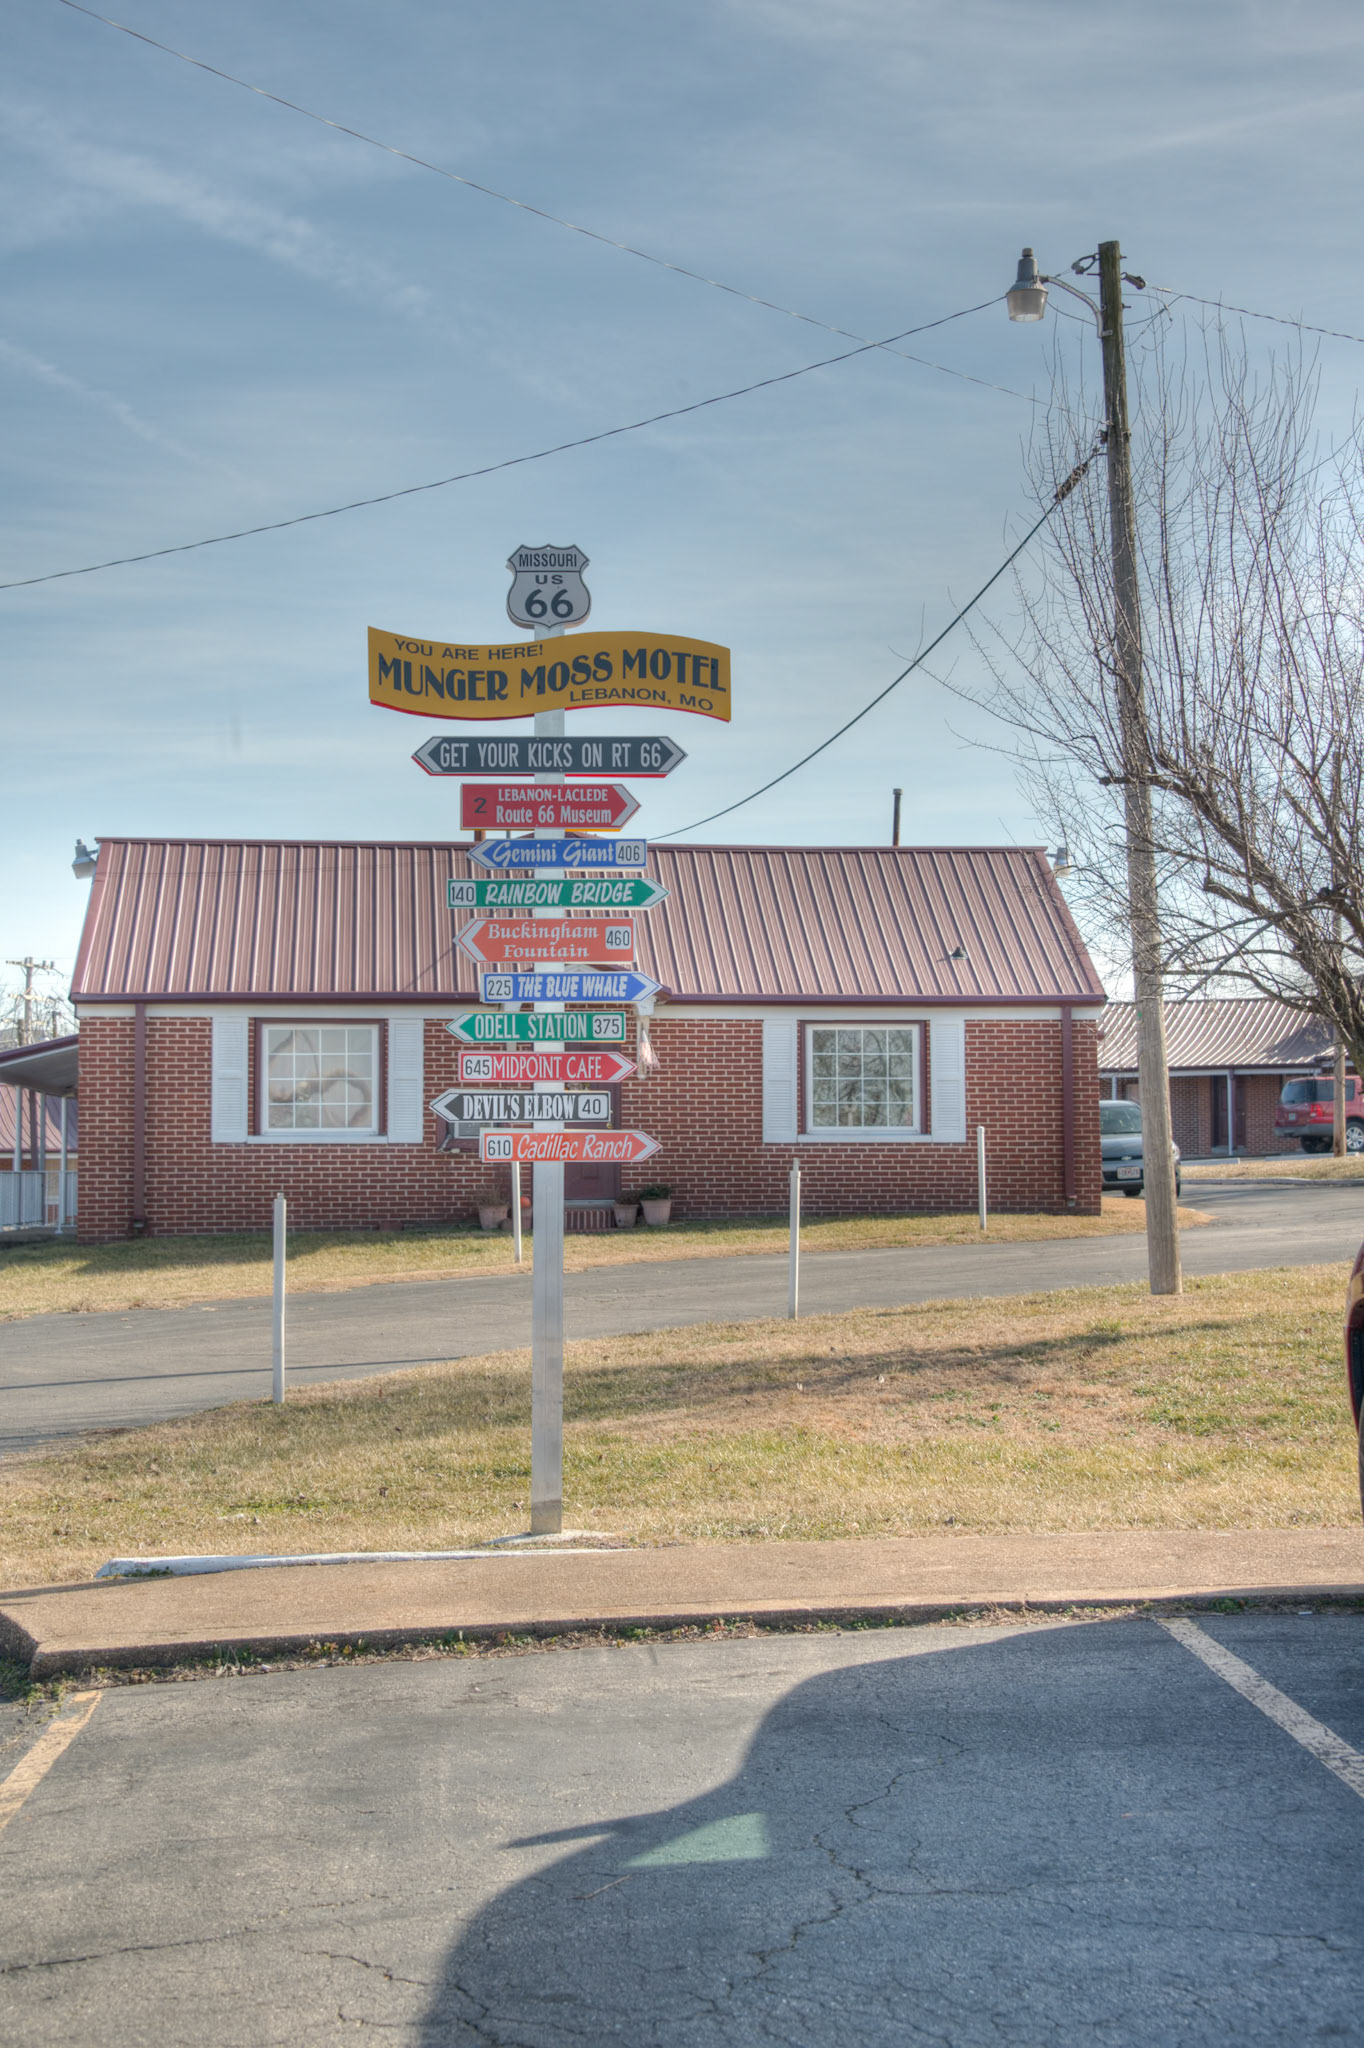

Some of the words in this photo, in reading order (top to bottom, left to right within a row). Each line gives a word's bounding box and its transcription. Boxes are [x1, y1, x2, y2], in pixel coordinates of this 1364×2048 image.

[519, 554, 577, 567] MISSOURI
[535, 574, 563, 585] US
[525, 589, 573, 618] 66
[394, 639, 433, 656] YOU
[441, 647, 479, 660] ARE
[488, 644, 543, 661] HERE!
[378, 653, 508, 701] MUNGER
[521, 651, 613, 698] MOSS
[622, 648, 727, 692] MOTEL
[570, 688, 671, 705] LEBANON,
[679, 694, 713, 711] MO
[440, 743, 468, 767] GET
[478, 743, 519, 767] YOUR
[528, 743, 572, 767] KICKS
[582, 743, 602, 767] ON
[612, 743, 631, 767] RT
[640, 743, 661, 767] 66
[498, 788, 608, 802] LEBANON-LACLEDE
[473, 797, 488, 814] 2
[496, 805, 533, 823] Route
[538, 805, 554, 823] 66
[560, 805, 611, 823] Museum
[492, 841, 556, 866] Gemini
[563, 842, 613, 866] Giant
[617, 845, 640, 861] 406
[451, 886, 475, 902] 140
[485, 883, 563, 904] RAINBOW
[571, 882, 634, 903] BRIDGE
[488, 922, 599, 944] Buckingham
[606, 930, 630, 946] 460
[503, 944, 589, 958] Fountain
[487, 980, 511, 996] 225
[517, 976, 542, 997] THE
[546, 976, 579, 997] BLUE
[583, 976, 628, 997] WHALE
[475, 1014, 519, 1039] ODELL
[528, 1014, 587, 1039] STATION
[594, 1018, 620, 1035] 375
[465, 1059, 490, 1075] 645
[492, 1057, 562, 1078] MIDPOINT
[567, 1056, 602, 1078] CAFE
[462, 1094, 520, 1120] DEVIL'S
[524, 1095, 576, 1120] ELBOW
[582, 1099, 601, 1115] 40
[487, 1139, 511, 1156] 610
[517, 1134, 578, 1159] Cadillac
[582, 1134, 632, 1159] Ranch
